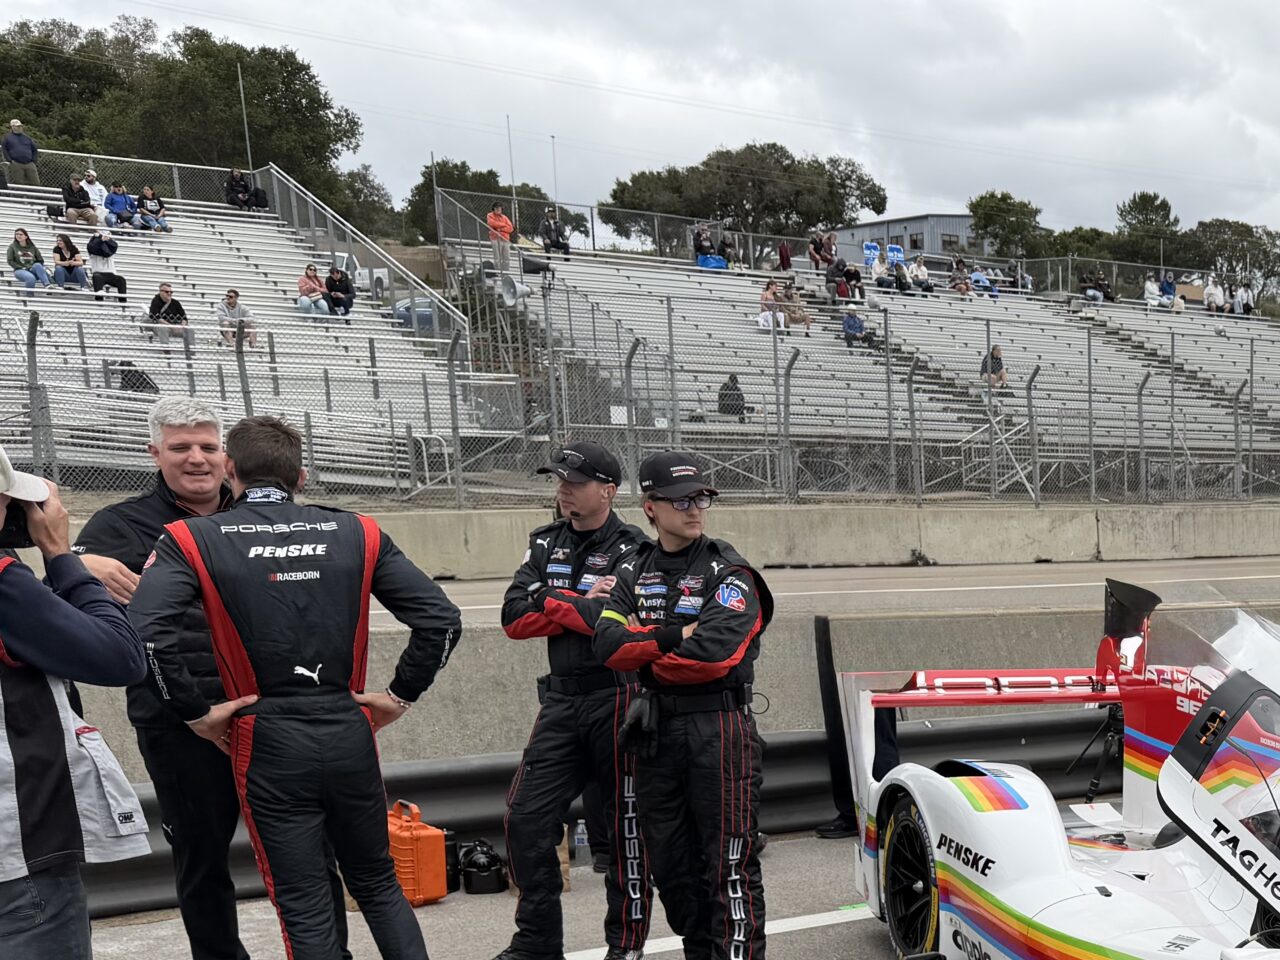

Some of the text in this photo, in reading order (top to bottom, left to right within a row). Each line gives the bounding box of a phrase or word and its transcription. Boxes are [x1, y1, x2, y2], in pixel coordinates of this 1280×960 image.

[220, 521, 338, 534] PORSCHE
[248, 543, 328, 558] PENSKE
[276, 570, 320, 581] RACEBORN
[118, 813, 135, 822] OMP
[624, 775, 643, 920] PORSCHE
[936, 832, 997, 877] PENSKE
